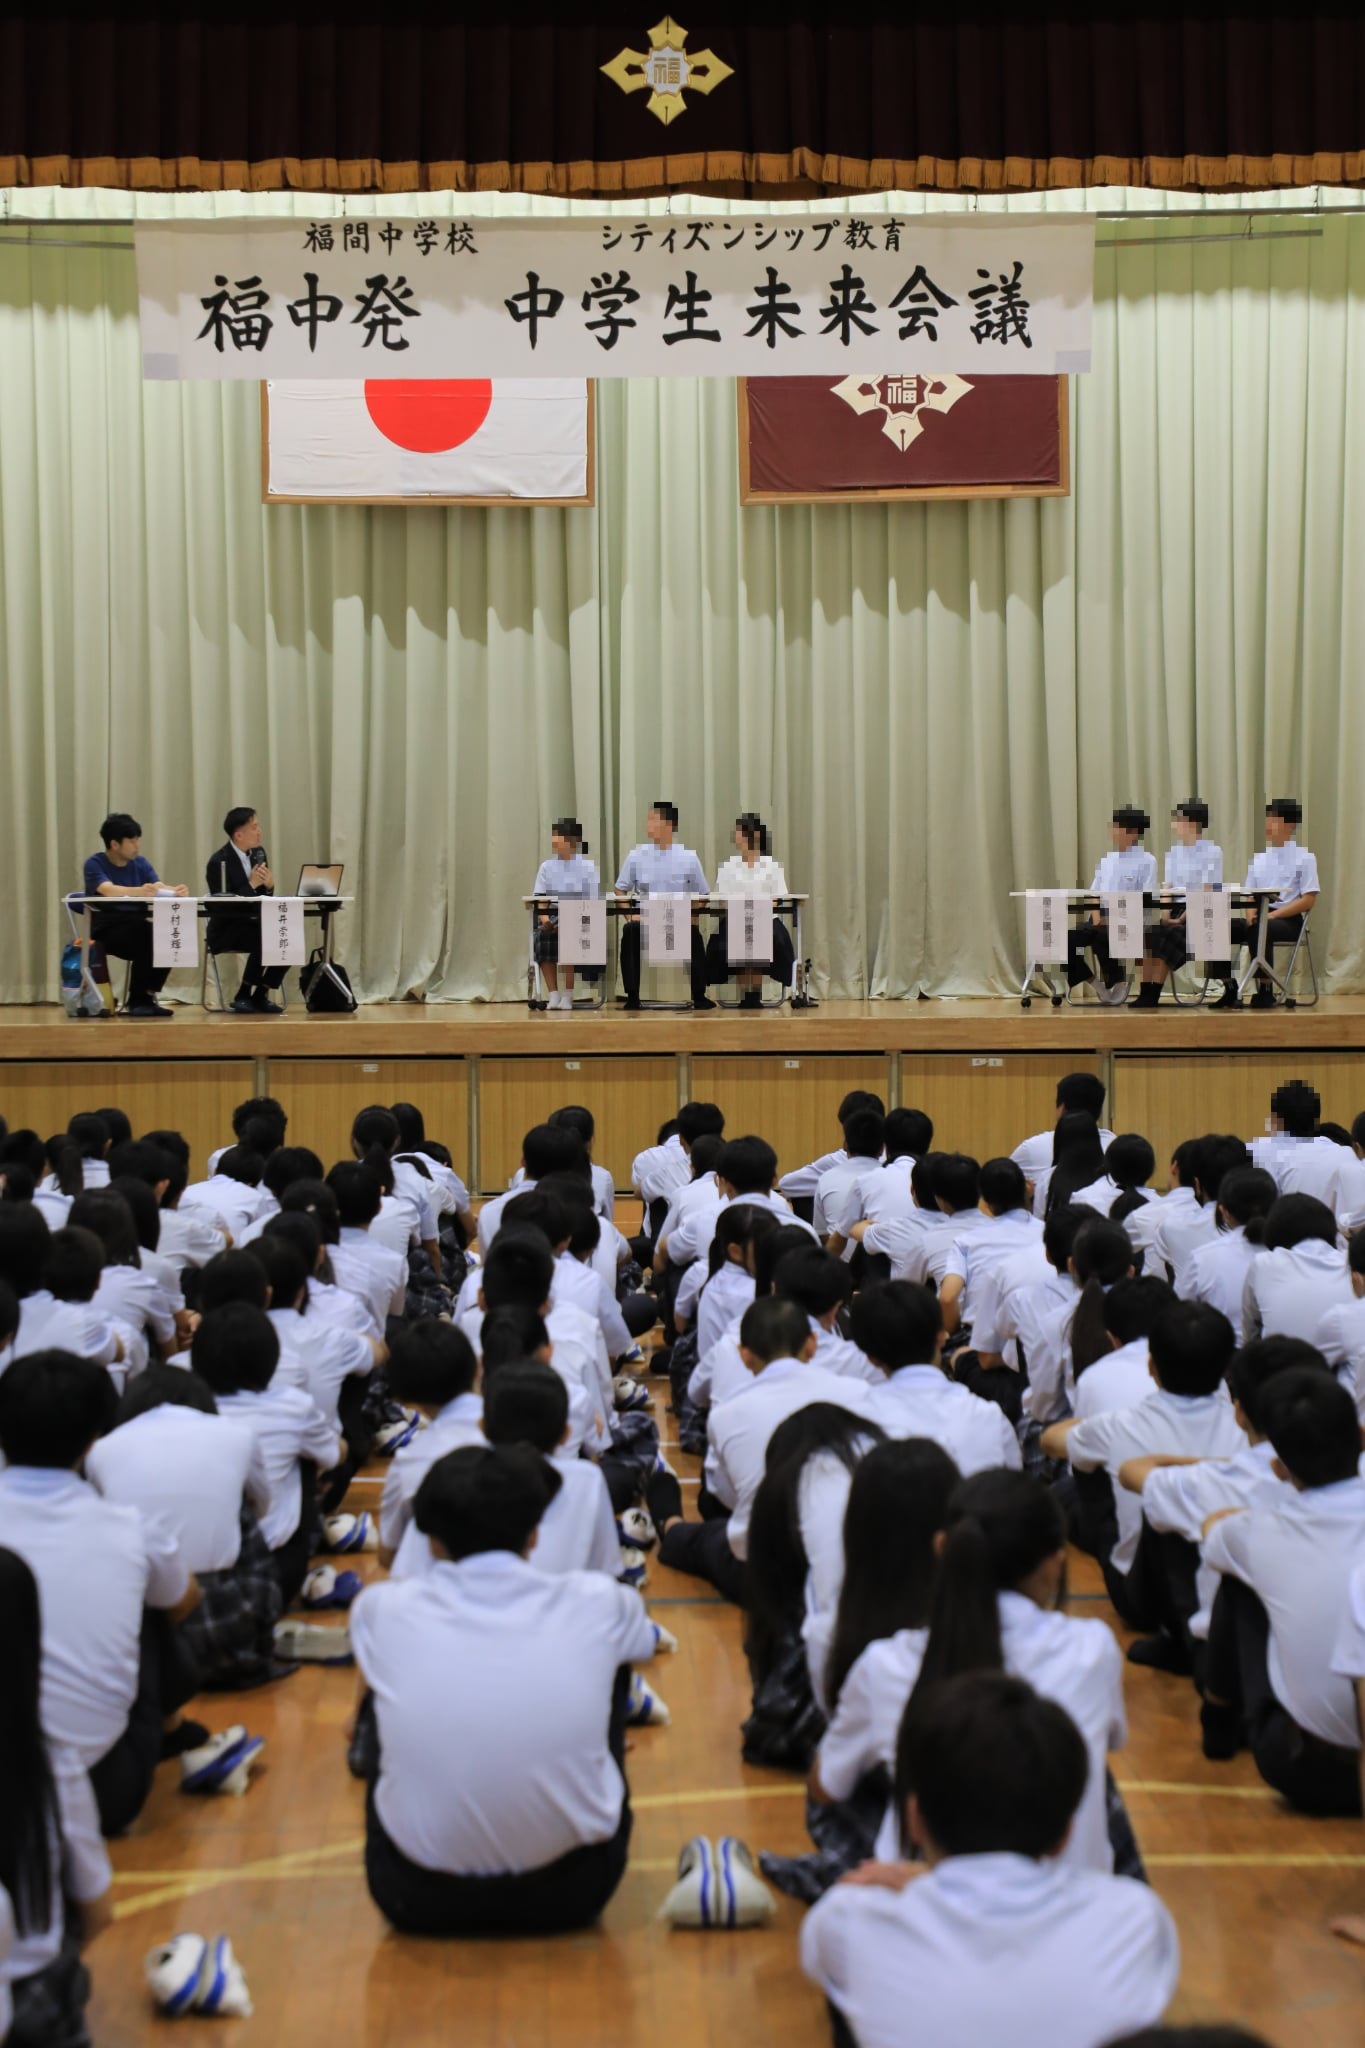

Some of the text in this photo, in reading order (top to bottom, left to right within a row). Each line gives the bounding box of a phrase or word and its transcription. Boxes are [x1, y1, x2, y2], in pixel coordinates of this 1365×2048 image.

[302, 217, 906, 256] 福間中学校 シティズンシップ教育
[197, 260, 1033, 353] 福中発 中学生未来会議
